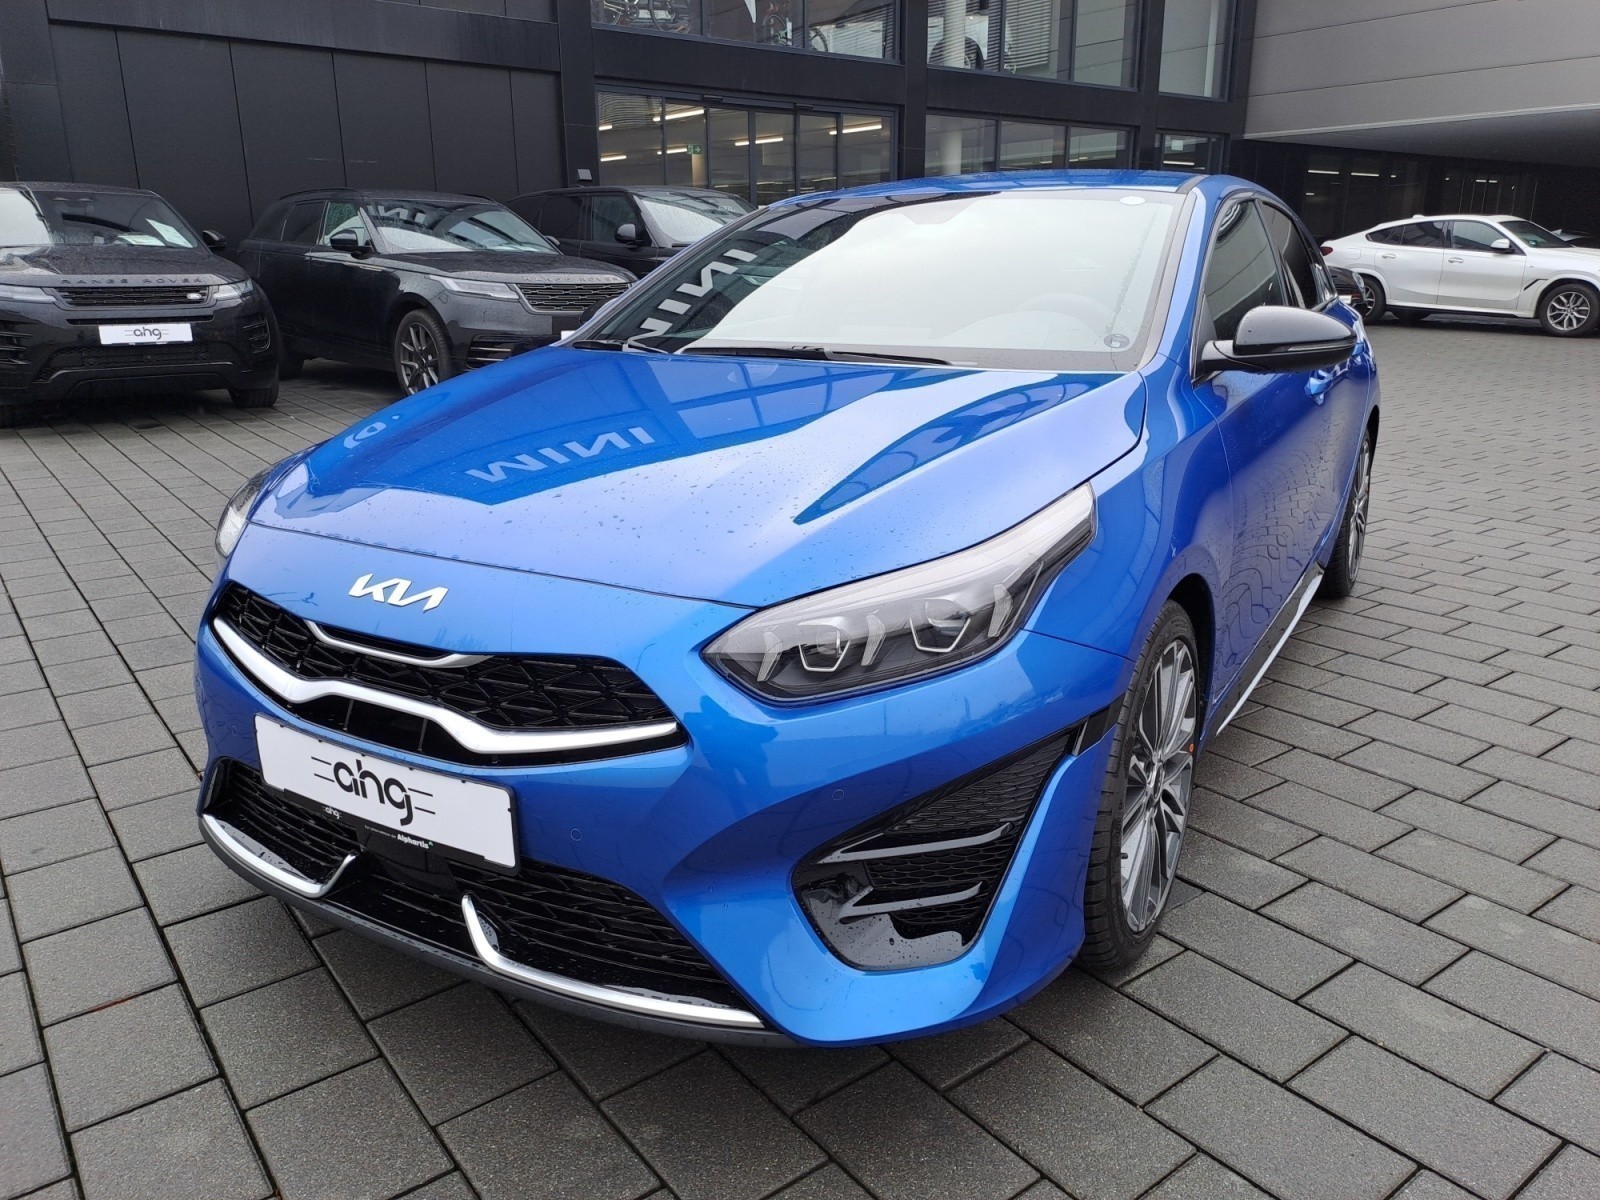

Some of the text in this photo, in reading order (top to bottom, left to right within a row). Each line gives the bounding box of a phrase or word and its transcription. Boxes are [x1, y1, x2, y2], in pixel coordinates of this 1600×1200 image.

[133, 326, 162, 340] ahg
[349, 573, 449, 612] KIA
[333, 759, 413, 826] ahg
